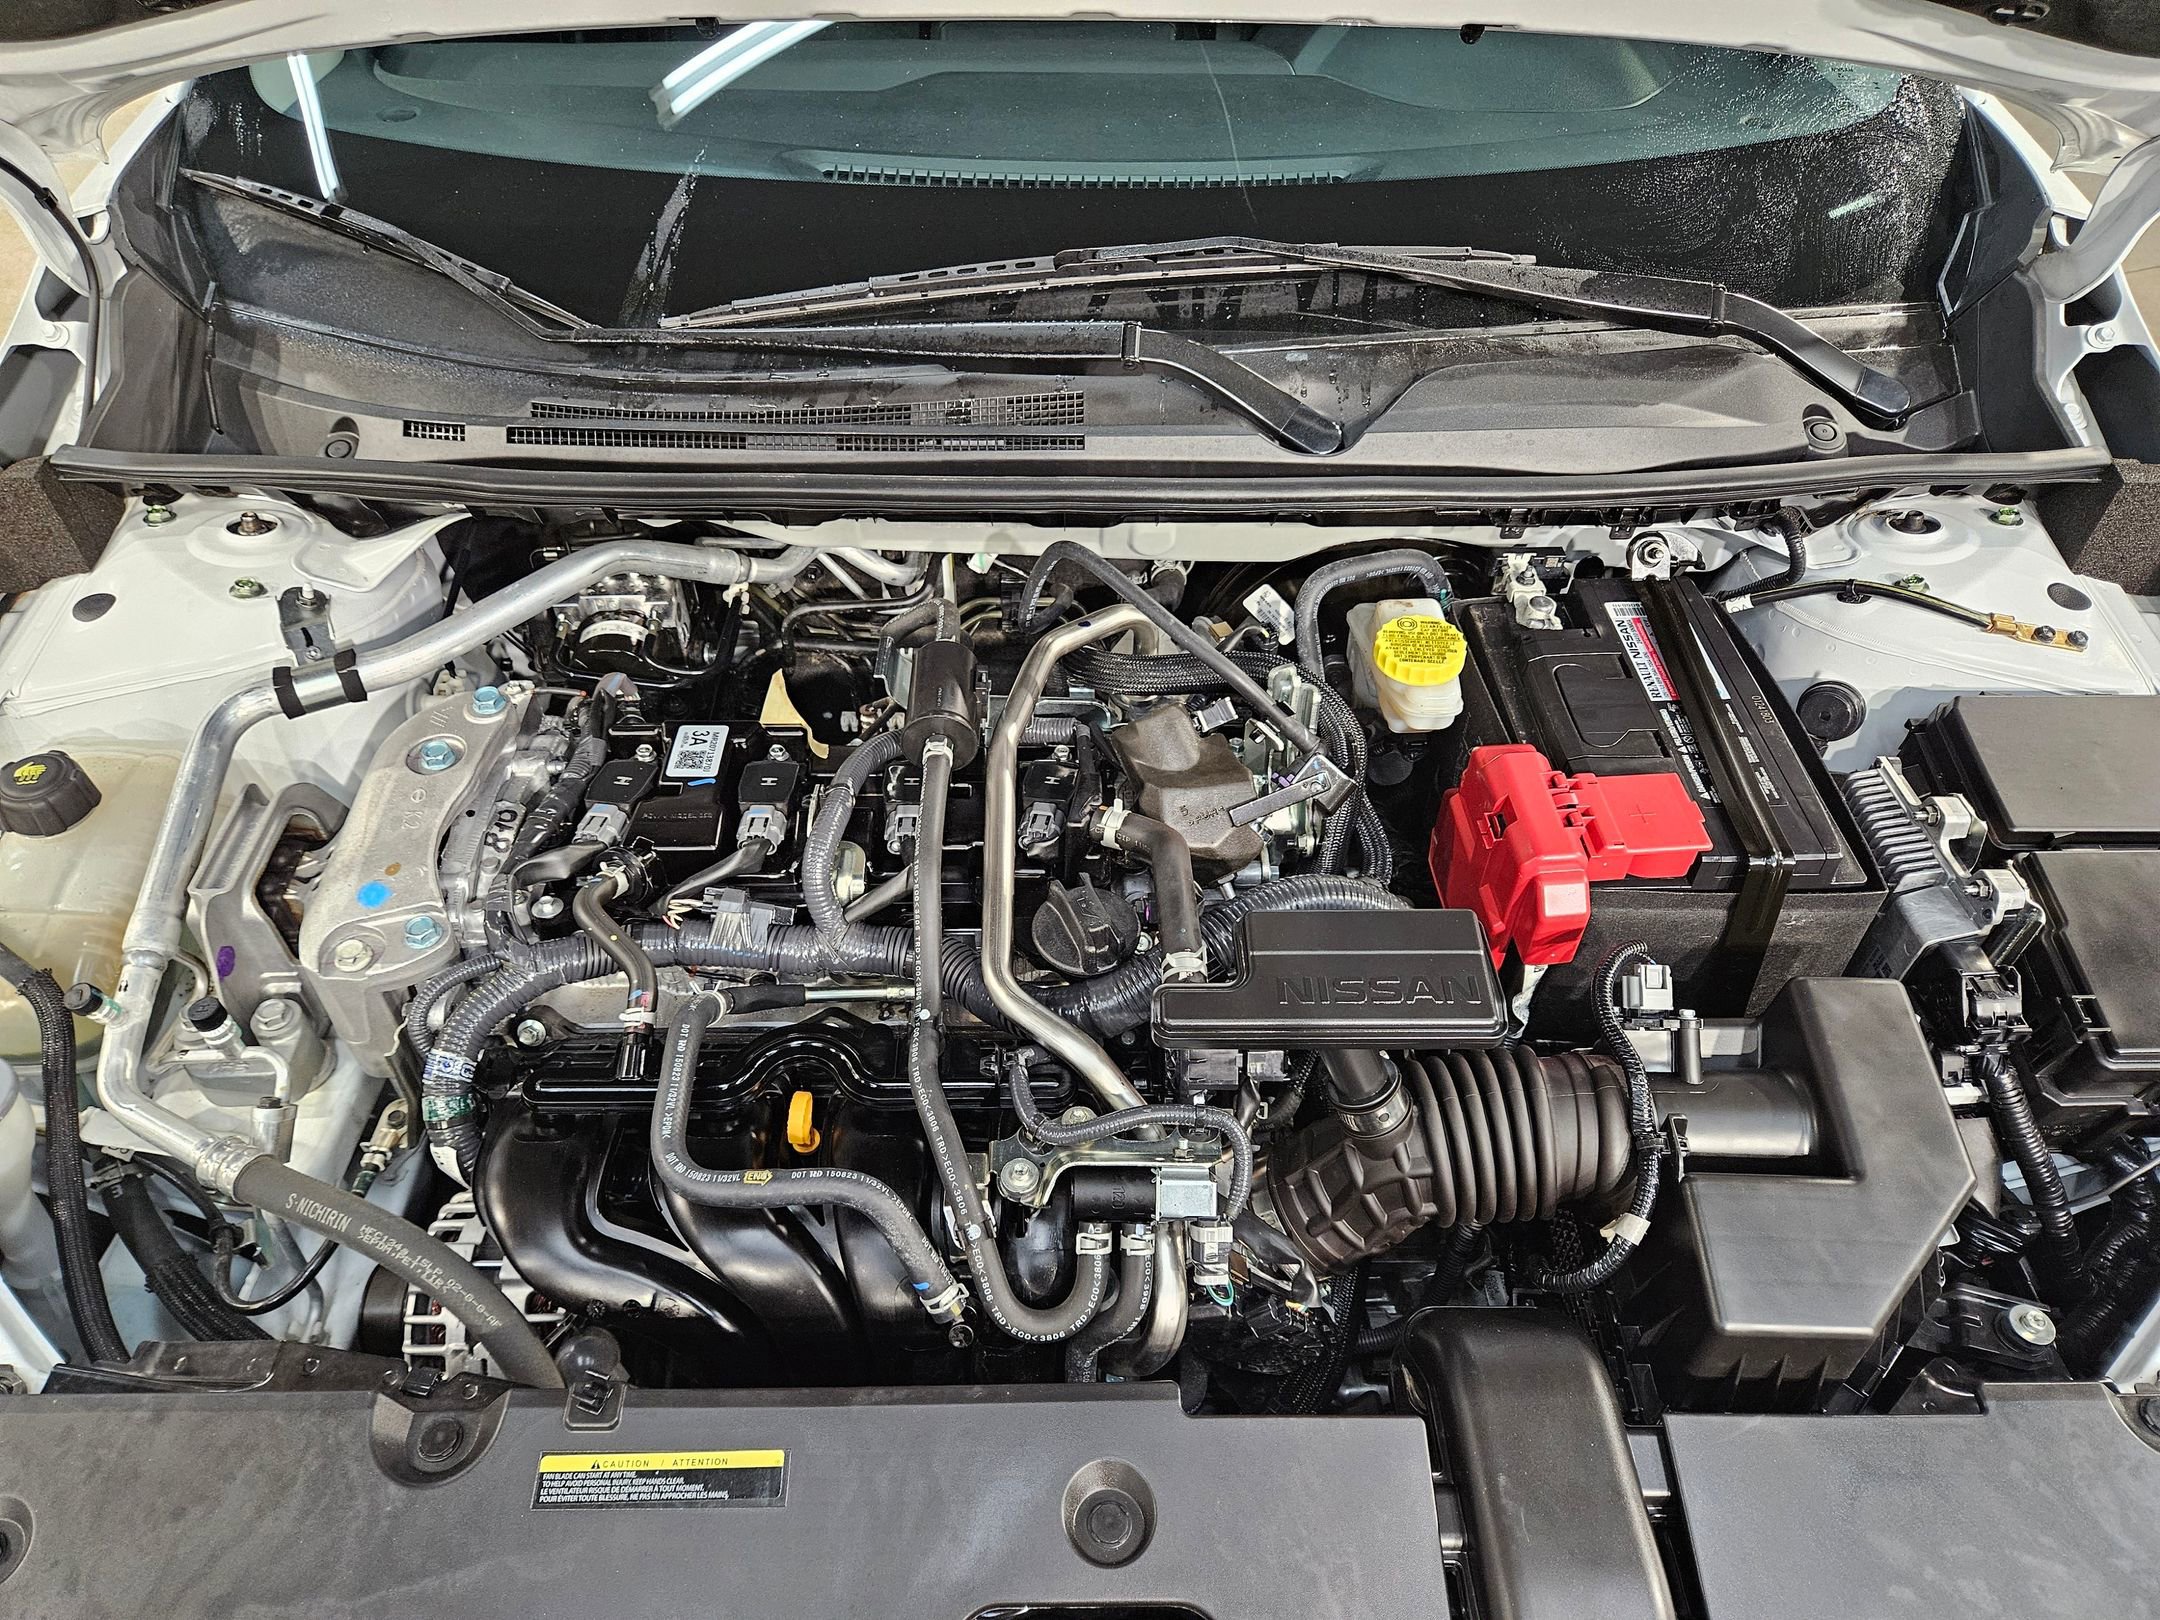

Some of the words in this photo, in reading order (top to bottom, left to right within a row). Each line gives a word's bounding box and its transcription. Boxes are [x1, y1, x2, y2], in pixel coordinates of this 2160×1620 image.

[1615, 619, 1642, 659] NISSAN
[1636, 661, 1662, 699] RENAULT
[689, 730, 710, 747] 3A
[1277, 975, 1483, 1005] NISSAN
[679, 1023, 691, 1040] DOT
[911, 1066, 939, 1132] TRD>ECO<3806
[664, 1152, 678, 1165] DOT
[791, 1170, 807, 1179] DOT
[826, 1170, 858, 1180] 150823
[935, 1134, 968, 1215] TRD>ECO<3806
[1069, 1254, 1102, 1332] TRD>ECO<3806
[991, 1305, 1066, 1342] TRD>ECO<3806
[602, 1459, 650, 1469] CAUTION
[672, 1458, 729, 1467] ATTENTION
[586, 1471, 602, 1479] START
[647, 1477, 666, 1485] HANDS
[549, 1487, 588, 1495] VENTILATEUR
[588, 1486, 611, 1494] RISQUE
[578, 1494, 598, 1502] TOUTE
[651, 1492, 660, 1500] EN
[660, 1491, 697, 1499] APPROCHER
